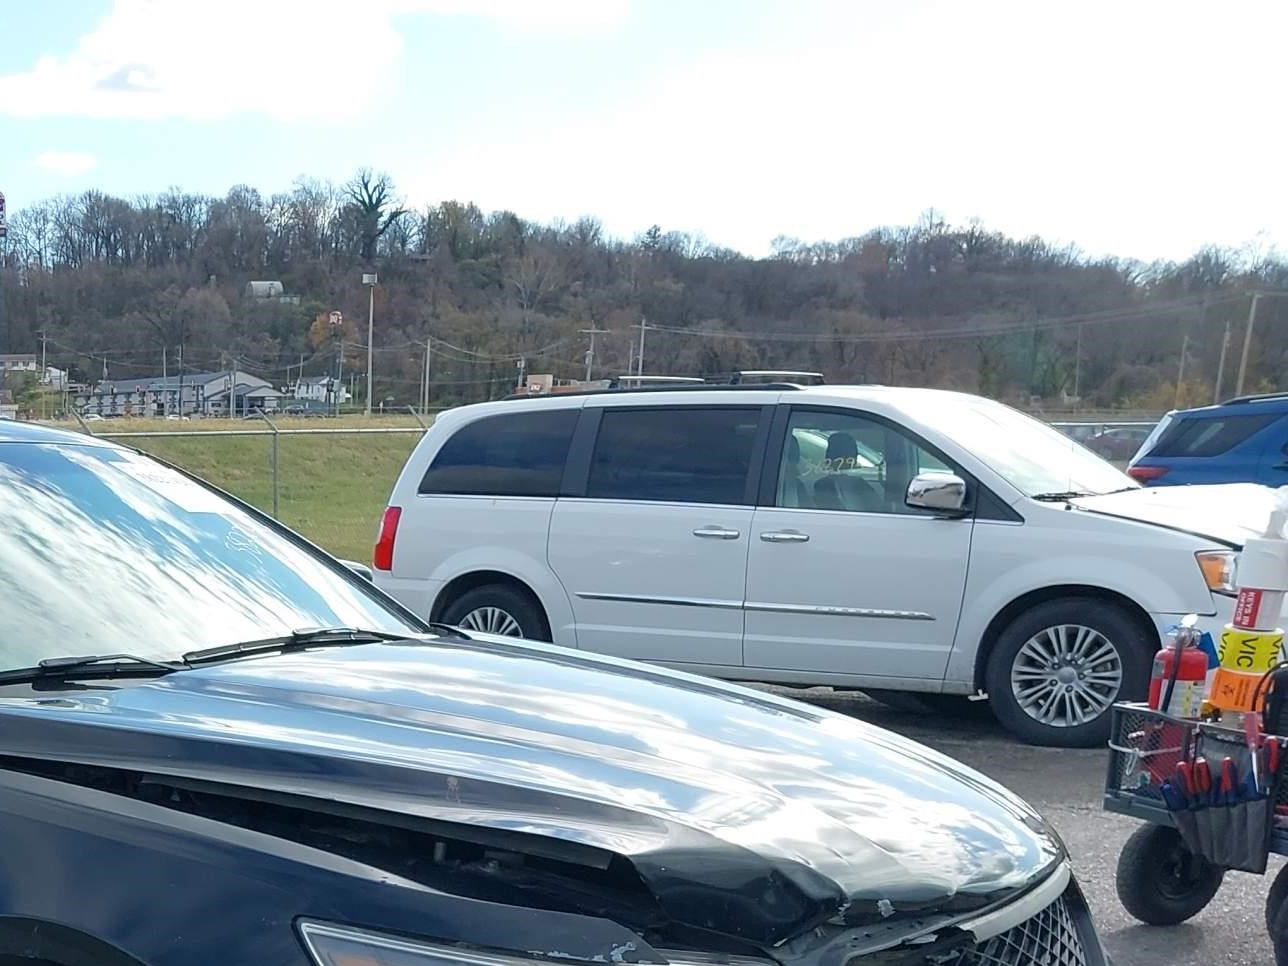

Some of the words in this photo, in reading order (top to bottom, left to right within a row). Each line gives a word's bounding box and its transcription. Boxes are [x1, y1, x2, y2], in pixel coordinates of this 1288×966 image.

[1245, 591, 1257, 613] KEYS
[1242, 615, 1249, 626] IN
[1236, 637, 1259, 668] VIC
